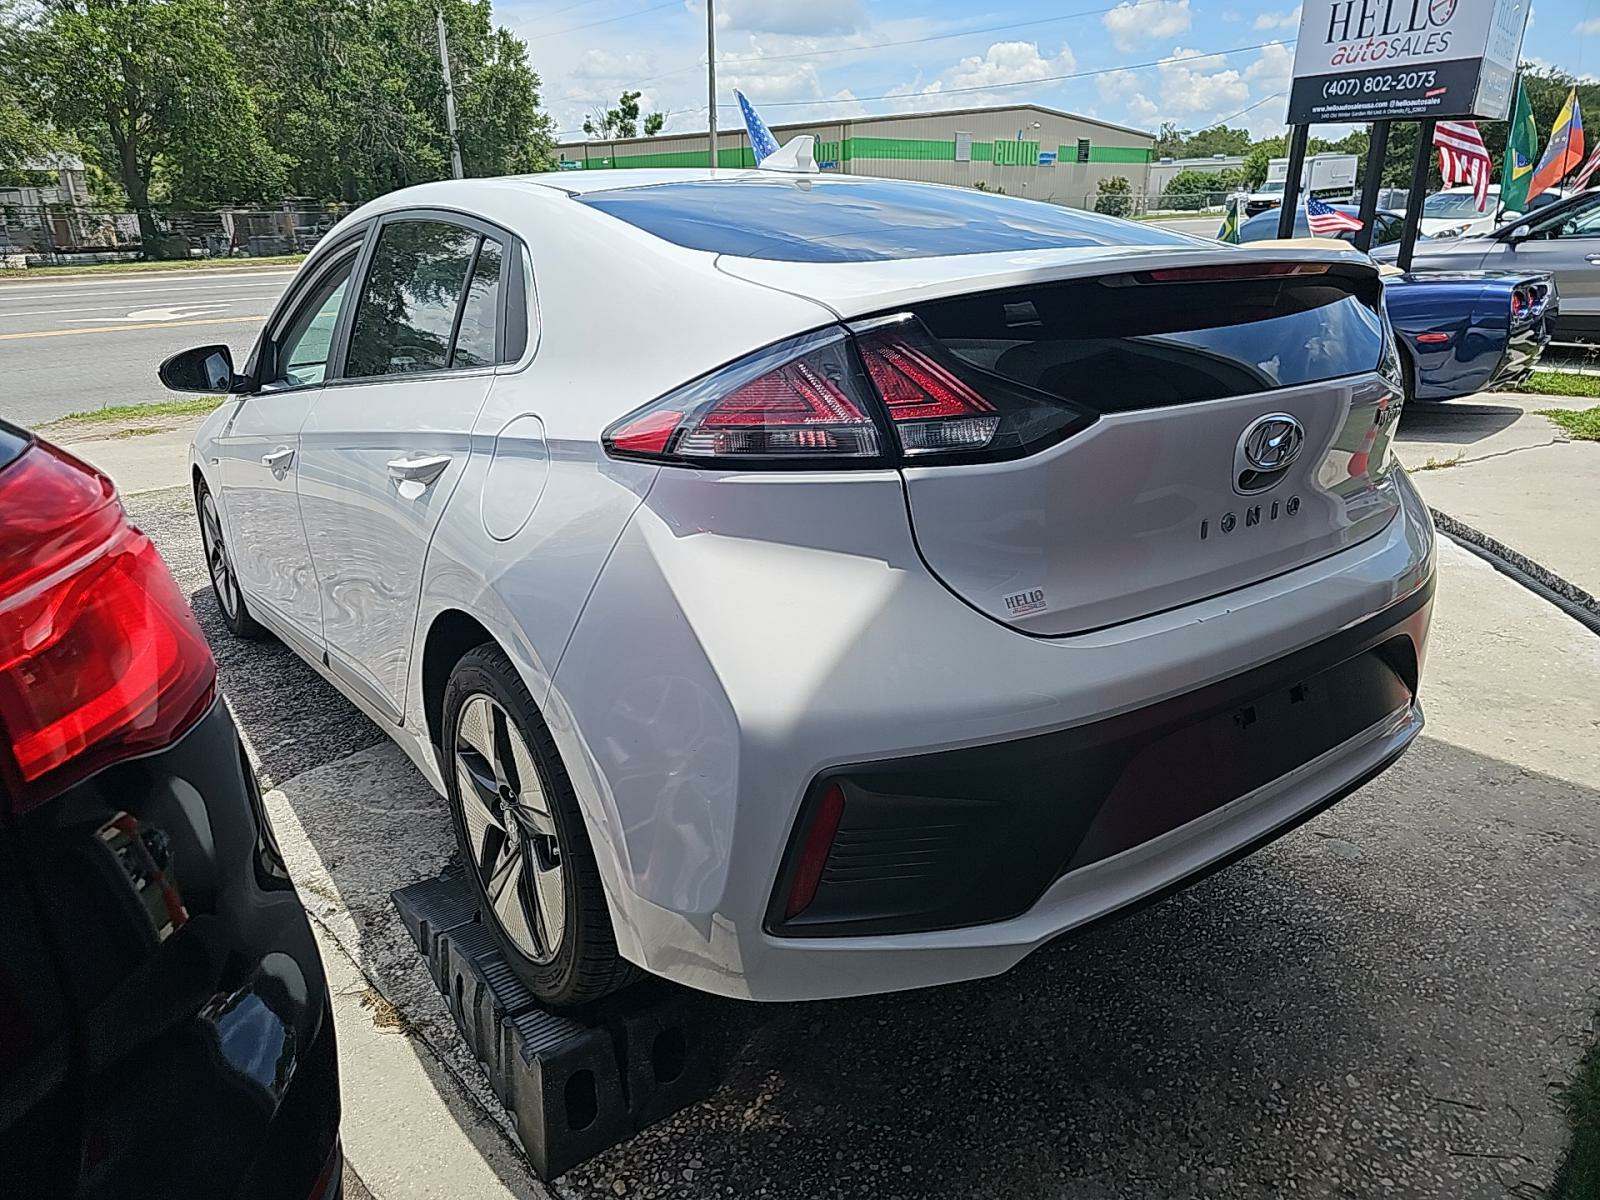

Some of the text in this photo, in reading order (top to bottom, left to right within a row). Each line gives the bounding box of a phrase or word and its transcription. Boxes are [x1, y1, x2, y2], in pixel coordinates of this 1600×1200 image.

[1324, 0, 1459, 45] HELLO
[1331, 31, 1453, 66] autoSALES
[1322, 78, 1361, 99] (407)
[1363, 70, 1436, 92] 802-2073
[1200, 495, 1301, 540] IONIQ
[1005, 590, 1044, 609] HELLO
